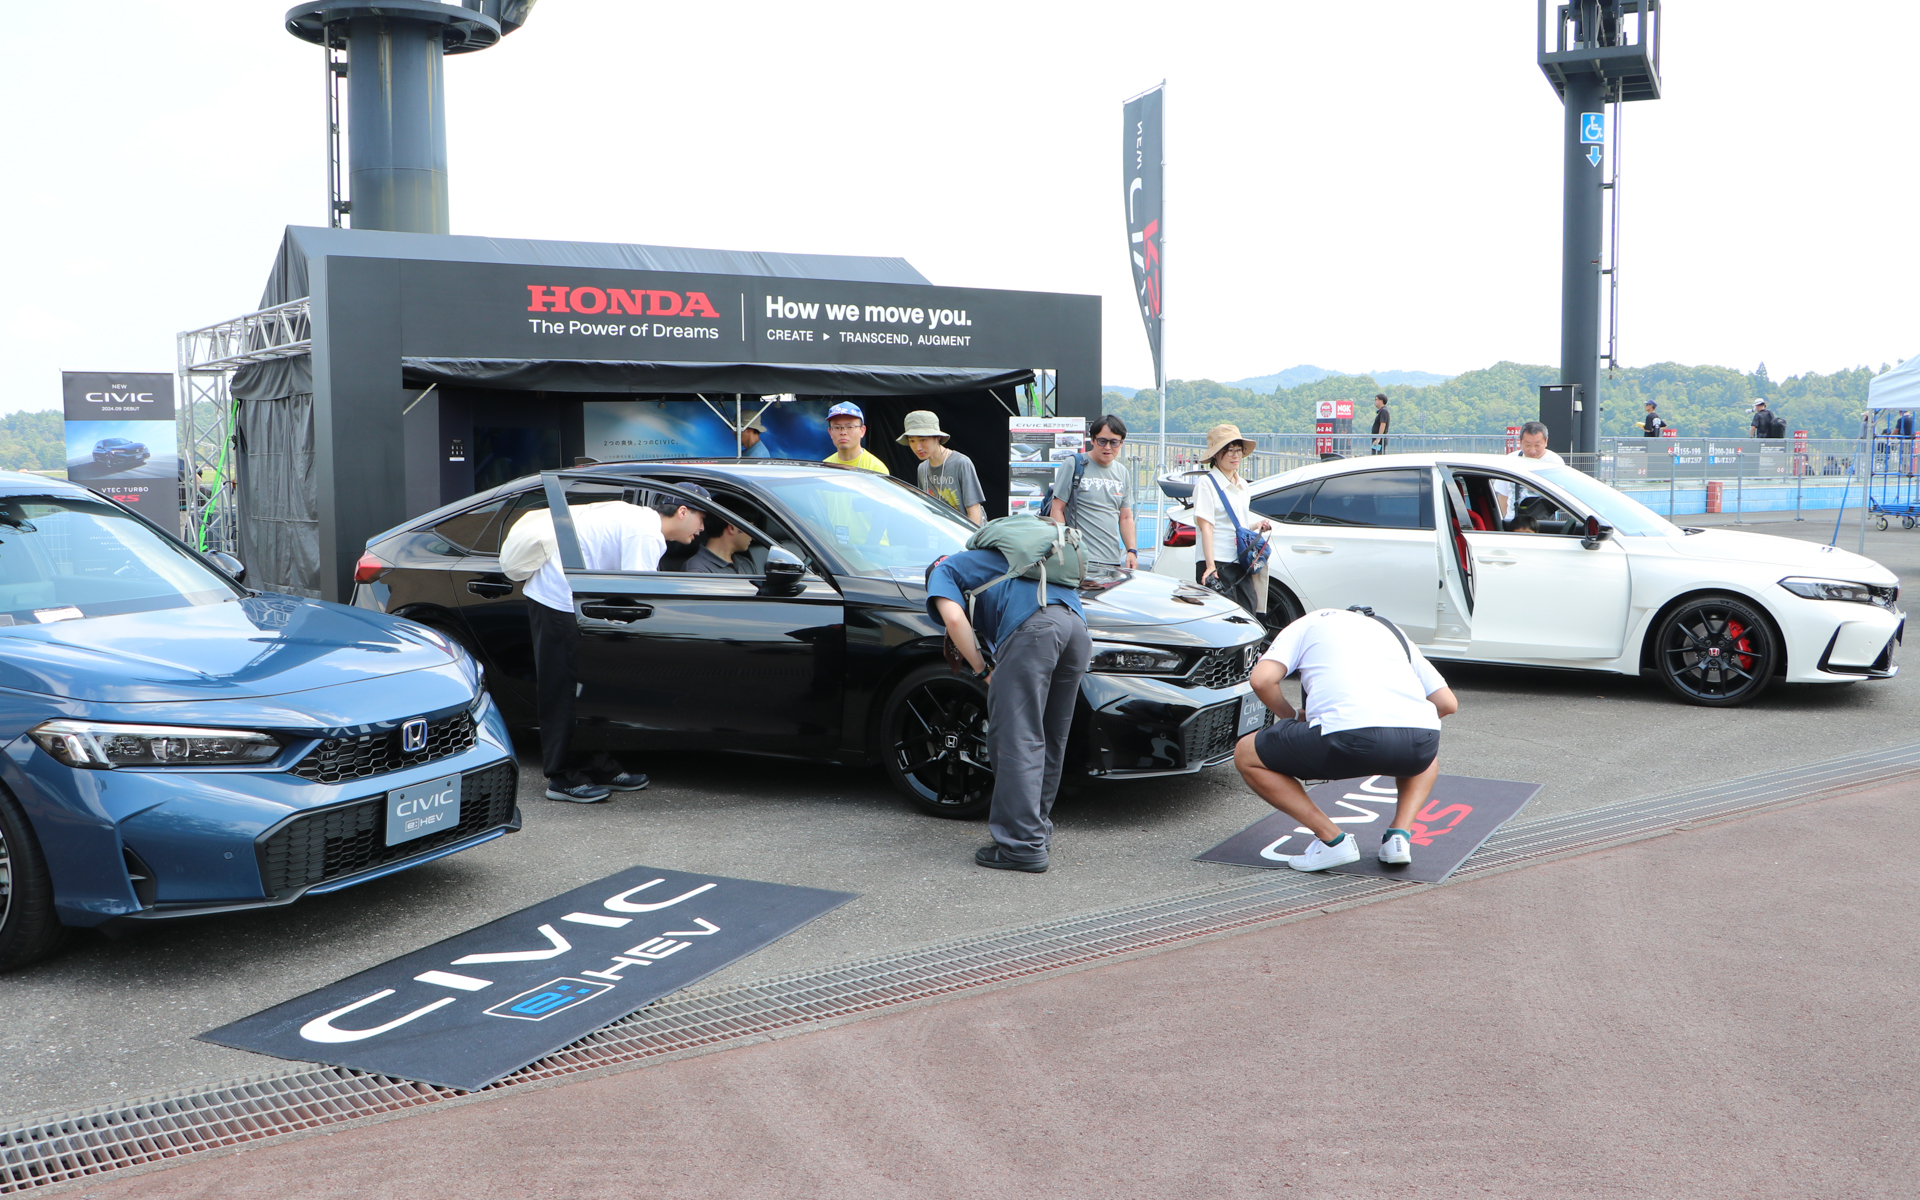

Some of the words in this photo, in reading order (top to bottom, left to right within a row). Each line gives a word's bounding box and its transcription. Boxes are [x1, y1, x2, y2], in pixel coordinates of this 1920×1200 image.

[527, 285, 720, 318] HONDA
[766, 295, 820, 320] How
[825, 303, 860, 321] we
[864, 304, 924, 324] move
[928, 307, 972, 330] you.
[529, 319, 565, 334] The
[569, 320, 626, 336] Power
[630, 323, 648, 337] of
[653, 323, 720, 340] Dreams
[766, 328, 814, 342] CREATE
[839, 331, 913, 347] TRANSCEND,
[917, 335, 971, 347] AUGMENT
[85, 392, 154, 403] CIVIC
[112, 494, 140, 502] RS
[1244, 700, 1265, 715] CIVIC
[1246, 714, 1260, 727] RS
[397, 789, 453, 817] CIVIC
[300, 878, 717, 1043] CIVIC
